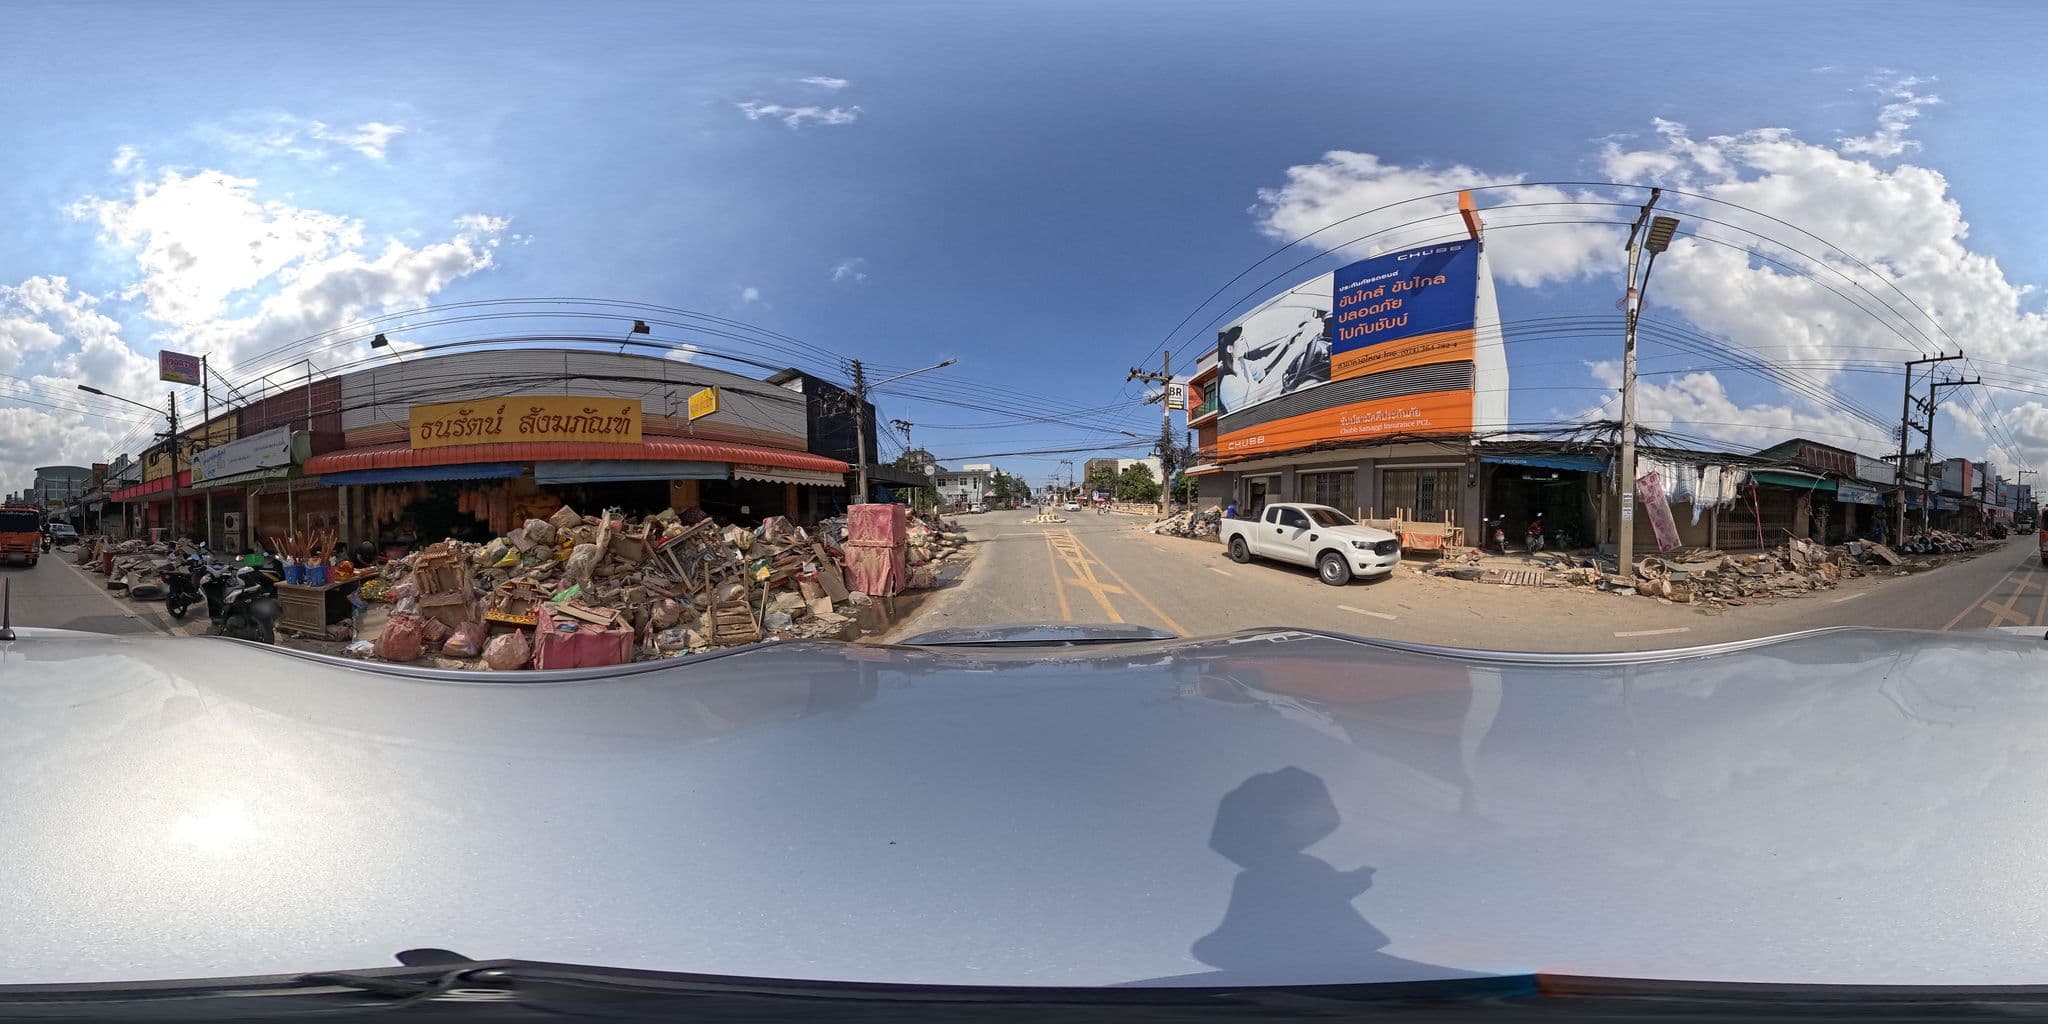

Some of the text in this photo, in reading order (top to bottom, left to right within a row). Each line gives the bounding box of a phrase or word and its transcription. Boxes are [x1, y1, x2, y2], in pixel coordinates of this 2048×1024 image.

[1397, 245, 1462, 261] CHUBB
[1339, 269, 1399, 292] ประกันภัยรถยนต์
[1339, 274, 1446, 308] ขับใกล้ ขับไกล
[1338, 298, 1402, 324] ปลอดภัย
[1338, 312, 1409, 341] ไปกับชับบ์
[1170, 387, 1182, 396] BR
[421, 405, 632, 440] ธนรัตน์ สังฆภัณฑ์
[1384, 420, 1415, 430] Insurance
[1228, 435, 1265, 450] CHUBB
